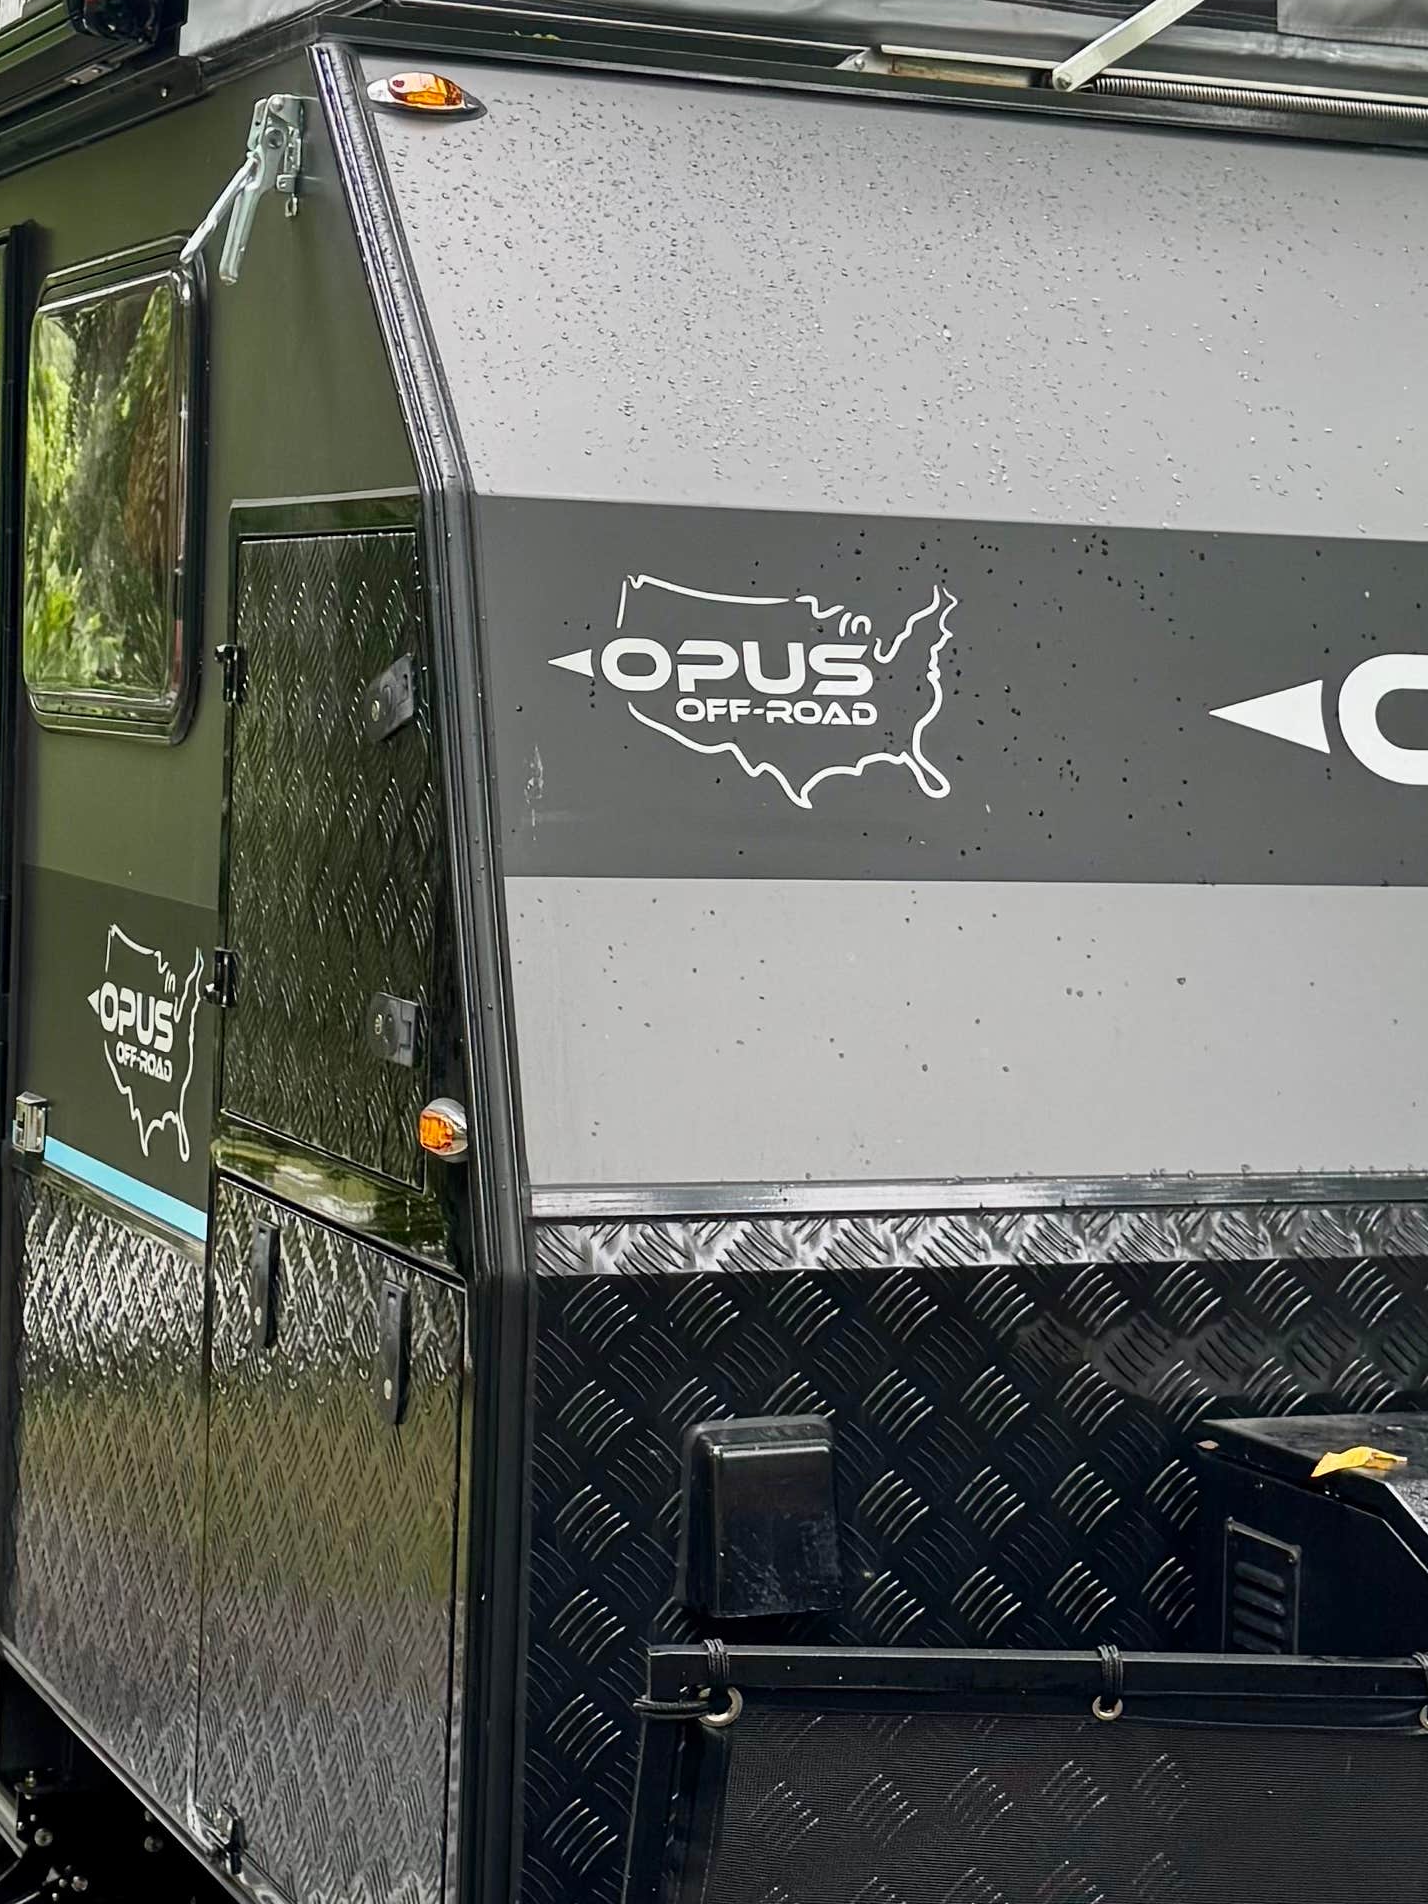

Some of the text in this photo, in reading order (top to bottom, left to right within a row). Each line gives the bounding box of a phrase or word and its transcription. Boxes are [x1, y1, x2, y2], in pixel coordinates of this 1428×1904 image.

[600, 636, 875, 697] OPUS
[675, 697, 878, 726] OFF-ROAD
[99, 981, 176, 1053] OPUS
[114, 1040, 173, 1083] OFF-ROAD
